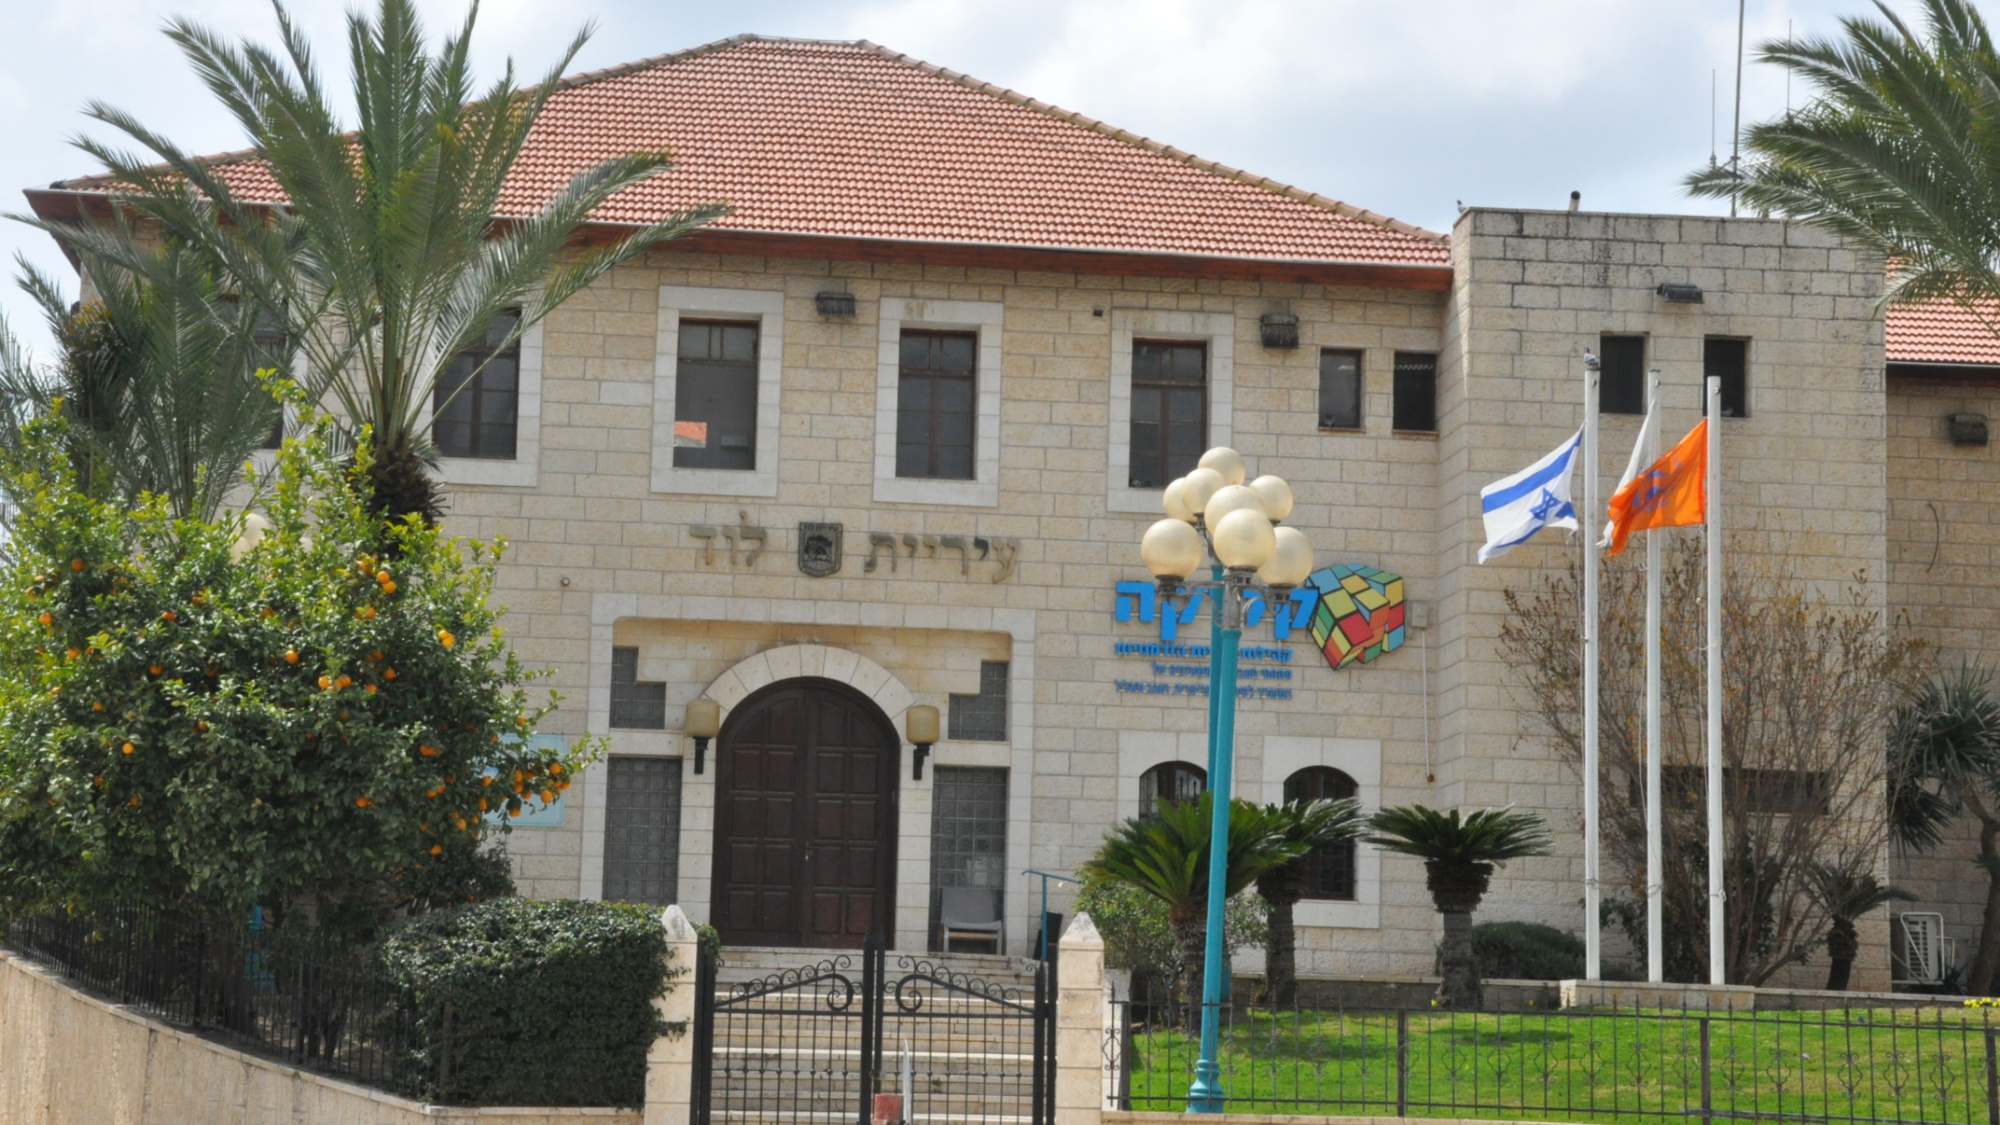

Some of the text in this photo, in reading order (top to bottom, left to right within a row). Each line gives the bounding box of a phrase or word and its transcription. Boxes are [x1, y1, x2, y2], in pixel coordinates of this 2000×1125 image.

[690, 510, 1022, 584] עיריית לוד
[1115, 581, 1319, 641] קלקה
[1114, 642, 1187, 657] הזדמנויות
[1241, 645, 1293, 664] קהילות
